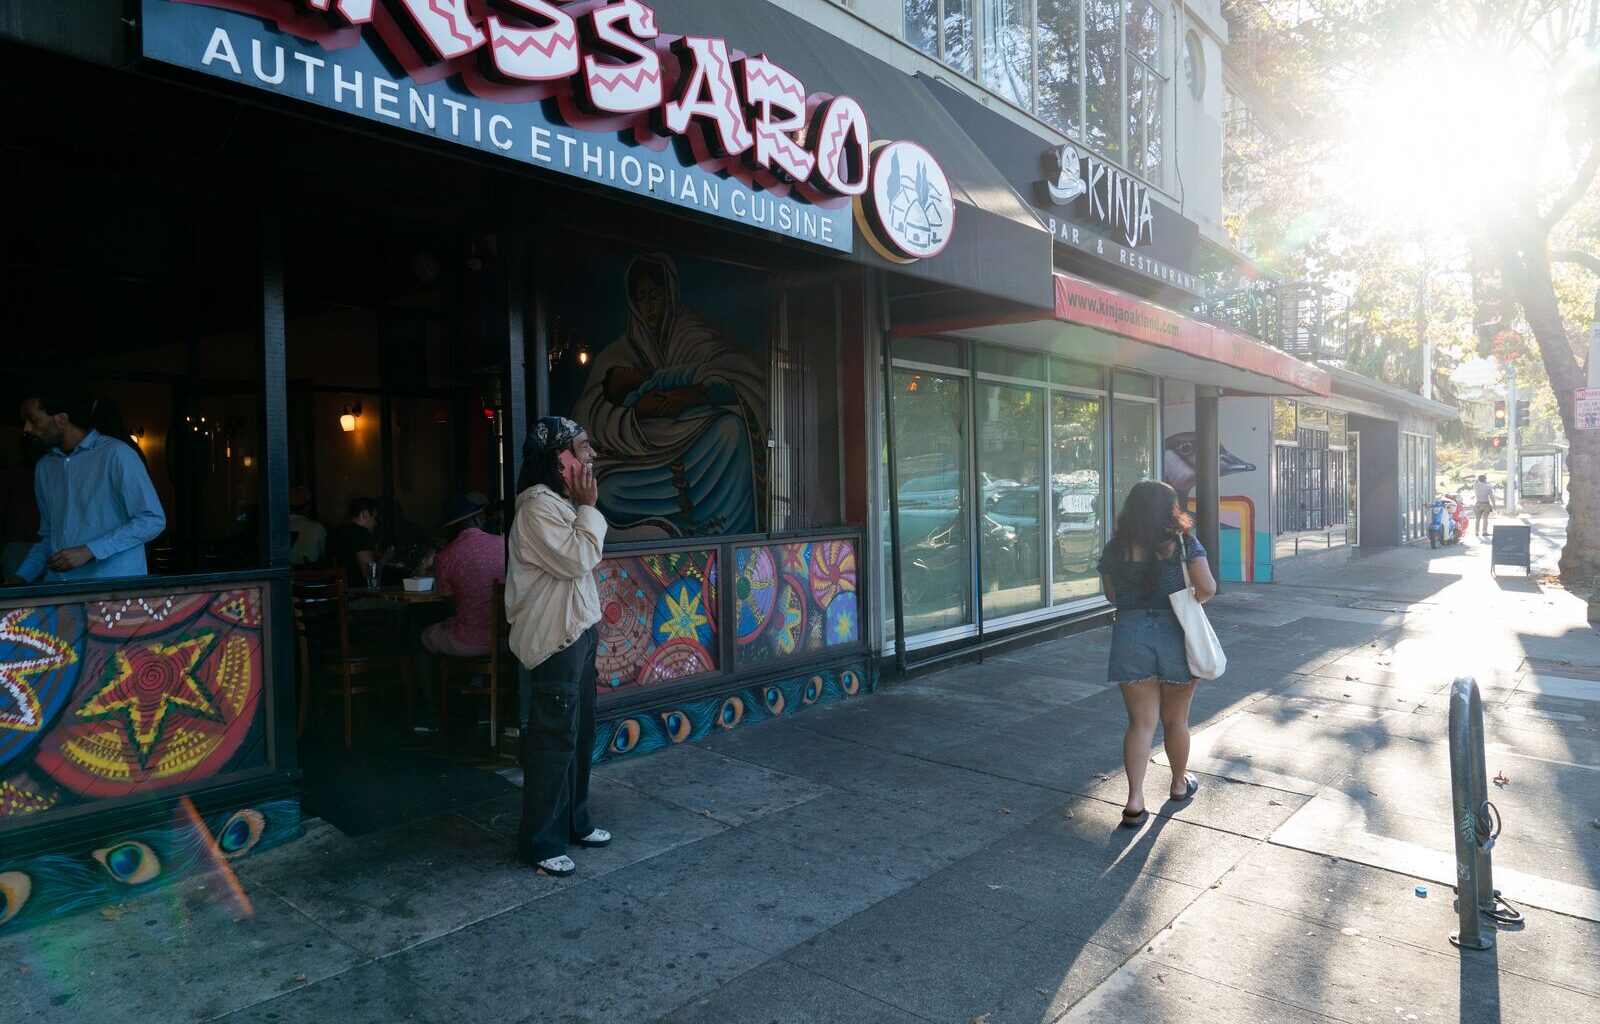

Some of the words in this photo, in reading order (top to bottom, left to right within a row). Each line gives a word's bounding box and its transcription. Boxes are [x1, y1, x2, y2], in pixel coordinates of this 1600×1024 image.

[201, 27, 514, 150] AUTHENTIC
[530, 125, 720, 211] ETHIOPIAN
[731, 189, 834, 243] CUISINE
[1087, 156, 1154, 247] KINJA
[1049, 218, 1079, 244] BAR
[1096, 239, 1104, 254] &
[1119, 249, 1197, 291] RESTAURANT
[1067, 291, 1180, 337] www.kinjaoakland.com
